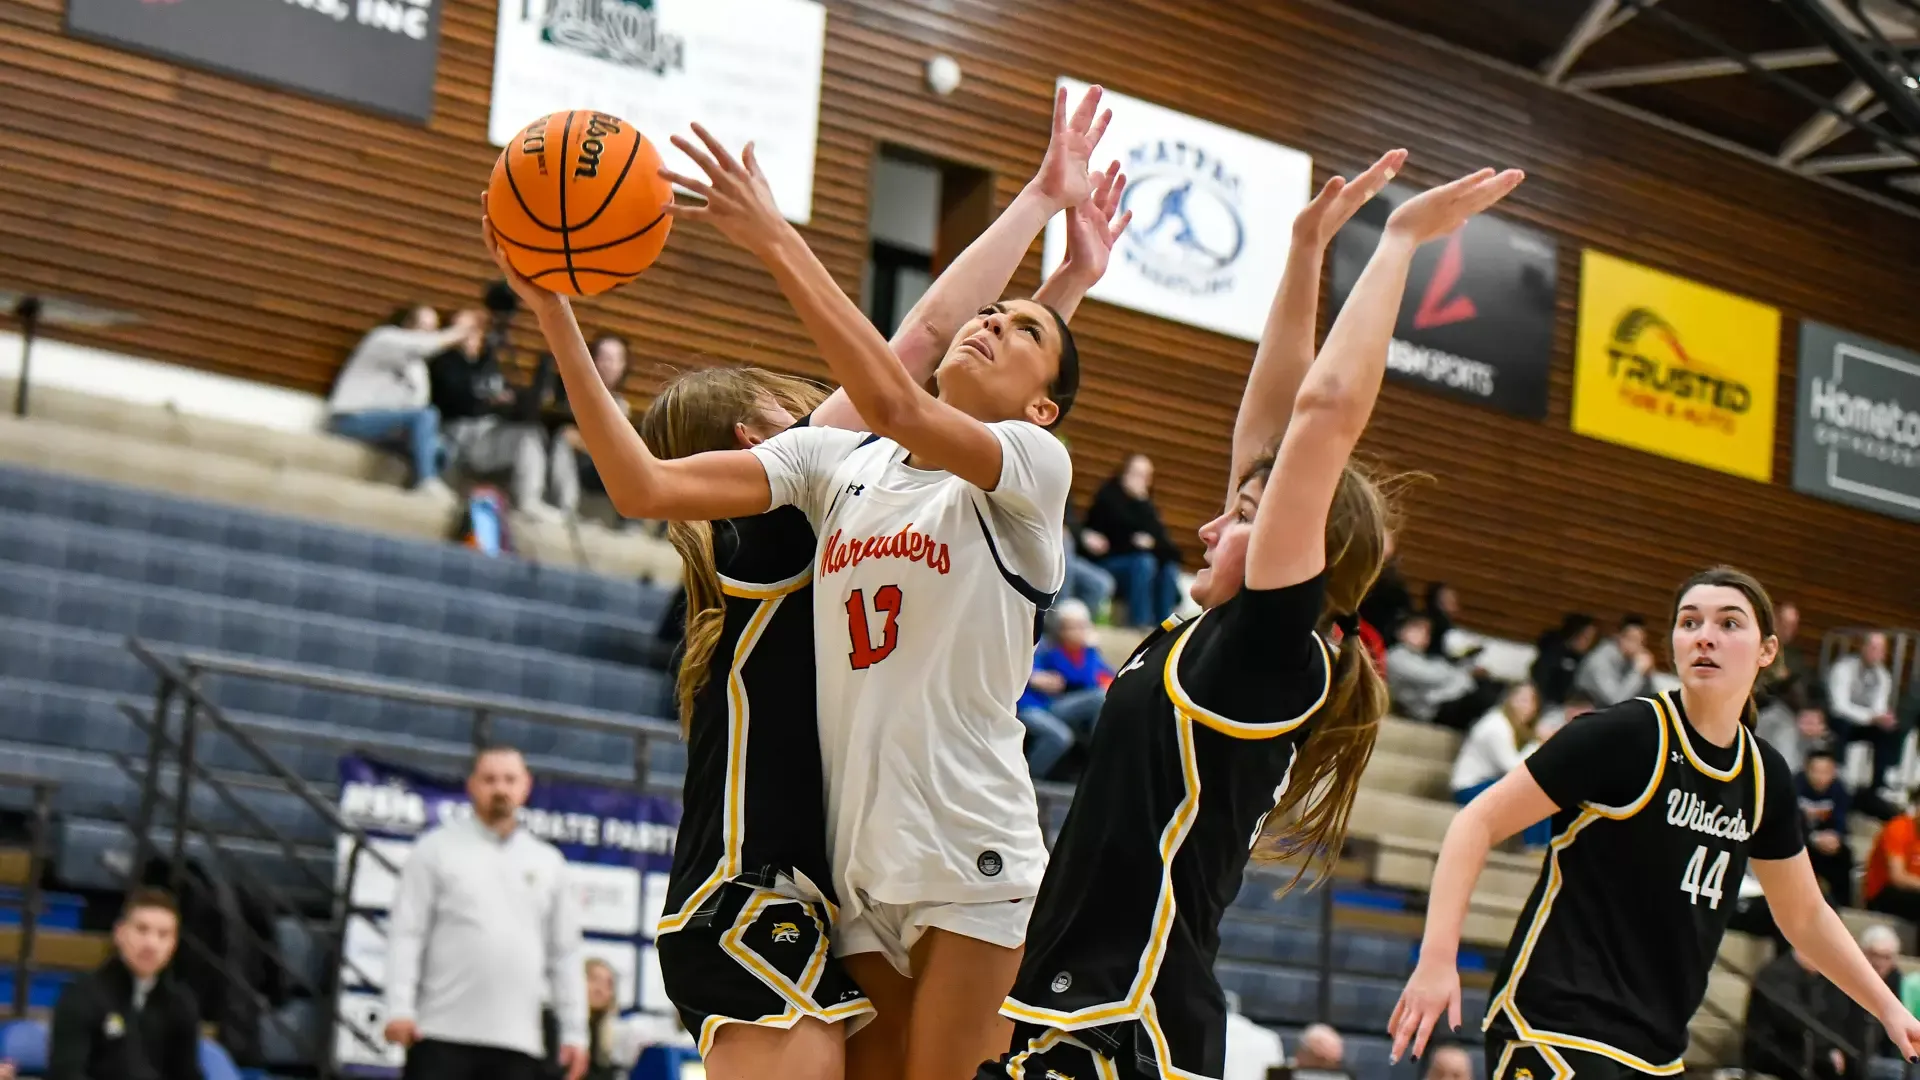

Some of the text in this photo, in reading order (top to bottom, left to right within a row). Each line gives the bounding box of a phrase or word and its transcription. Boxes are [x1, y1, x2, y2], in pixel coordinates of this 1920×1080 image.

[1605, 347, 1751, 415] TRUSTED
[819, 522, 951, 584] Marauders
[845, 584, 903, 671] 13
[1680, 844, 1731, 910] 44
